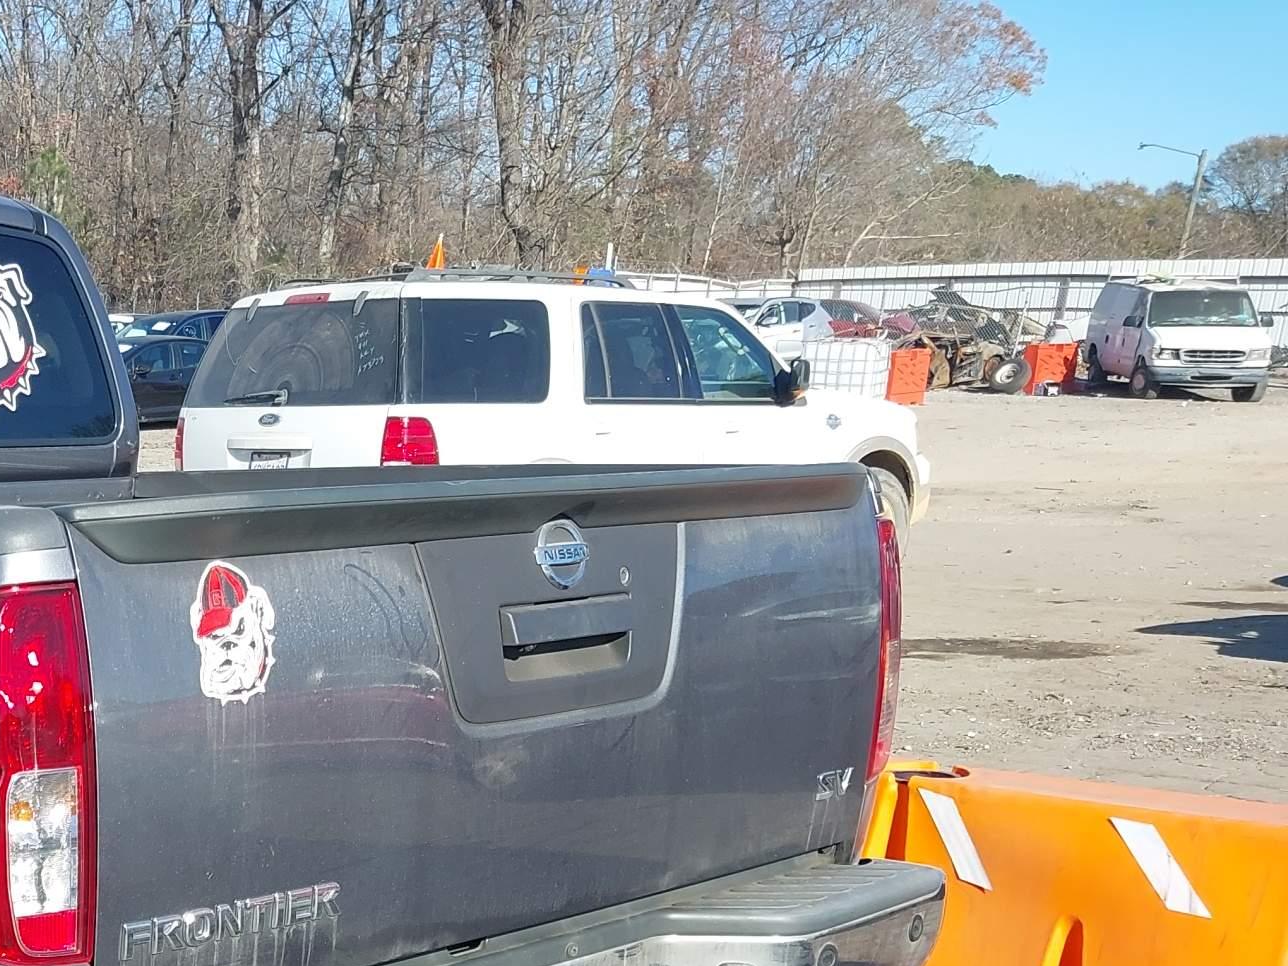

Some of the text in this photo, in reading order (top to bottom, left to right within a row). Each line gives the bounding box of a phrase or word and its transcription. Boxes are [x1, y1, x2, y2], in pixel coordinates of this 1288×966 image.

[543, 546, 586, 561] NISSAN
[815, 766, 855, 801] SV
[118, 881, 342, 961] FRONTIER
